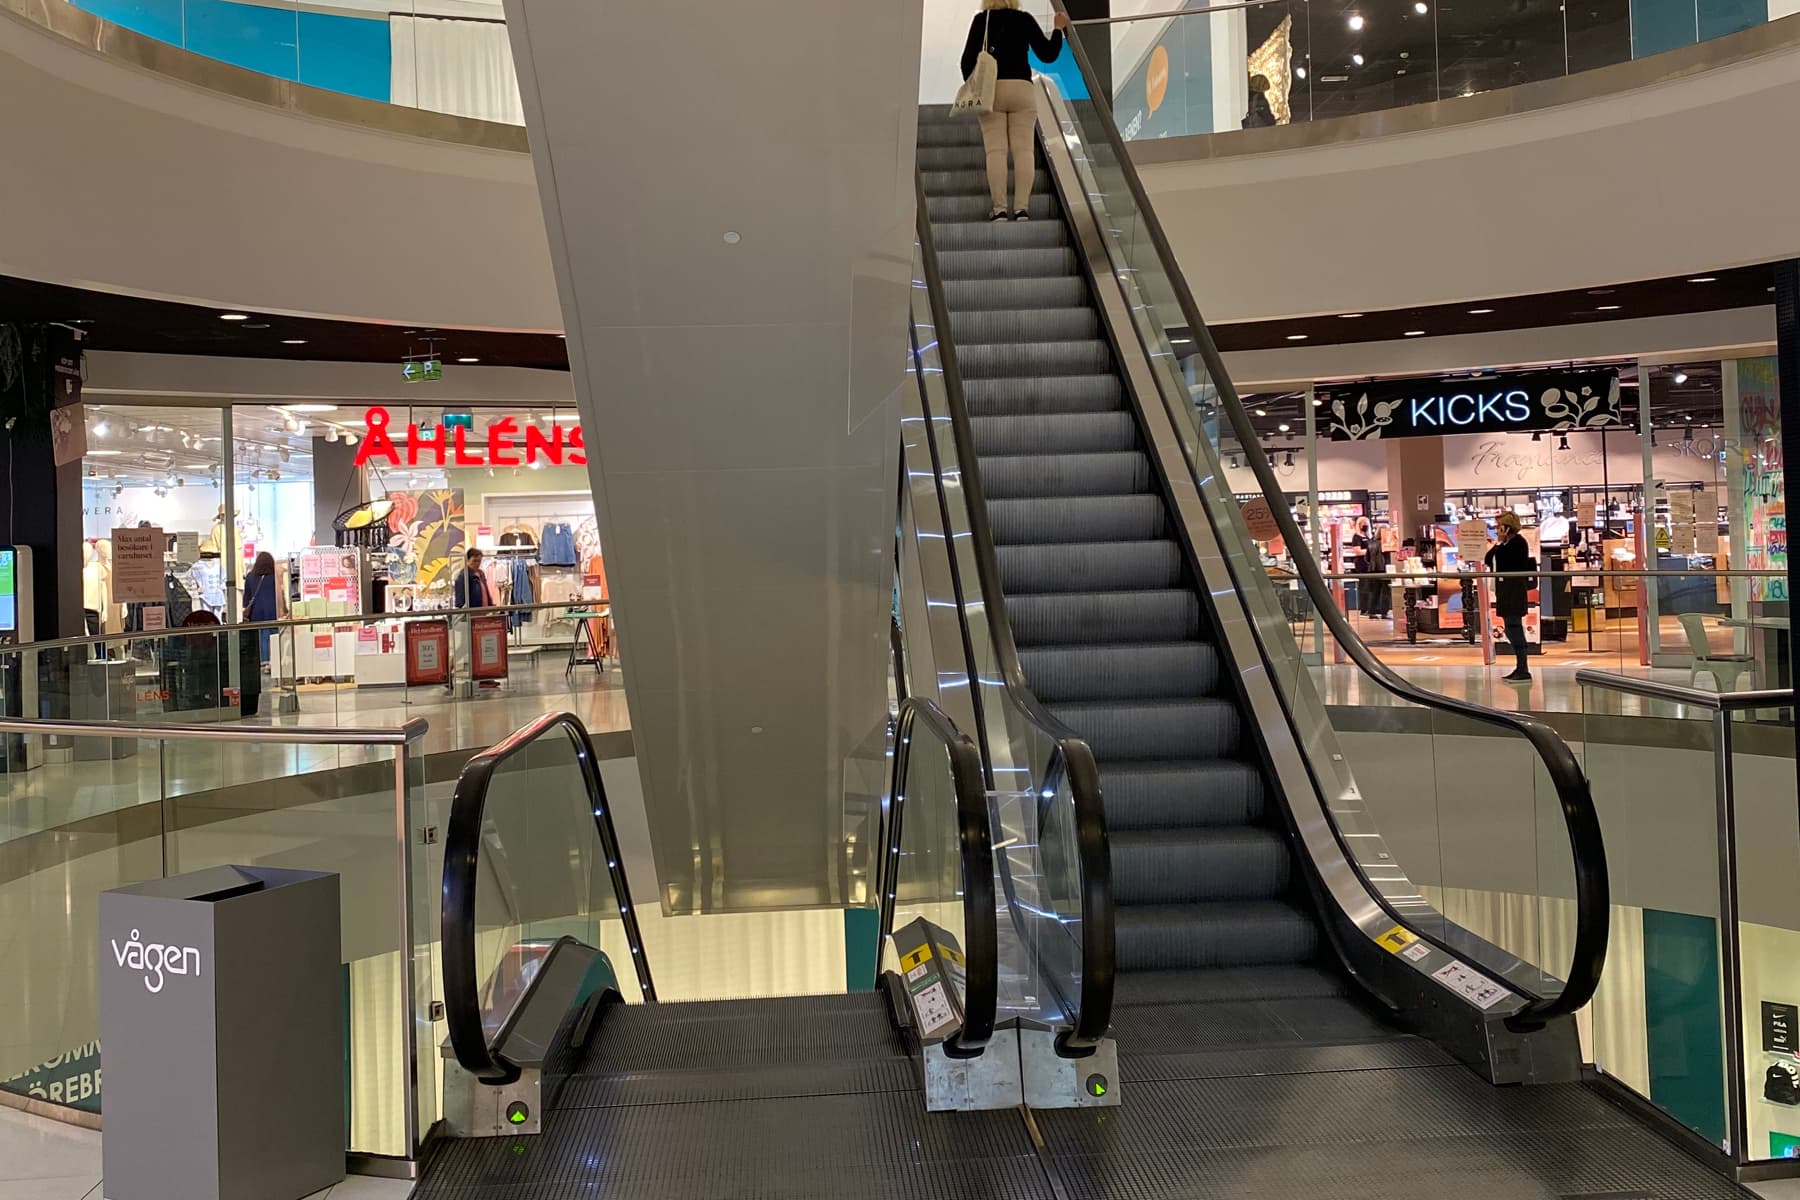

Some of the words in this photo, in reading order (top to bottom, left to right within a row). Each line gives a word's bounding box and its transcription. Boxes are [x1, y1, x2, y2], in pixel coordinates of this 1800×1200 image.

[1411, 391, 1530, 427] KICKS
[353, 406, 588, 466] ÅHLÉNS
[118, 535, 133, 543] Max
[134, 534, 152, 542] antal
[111, 928, 200, 993] vågen
